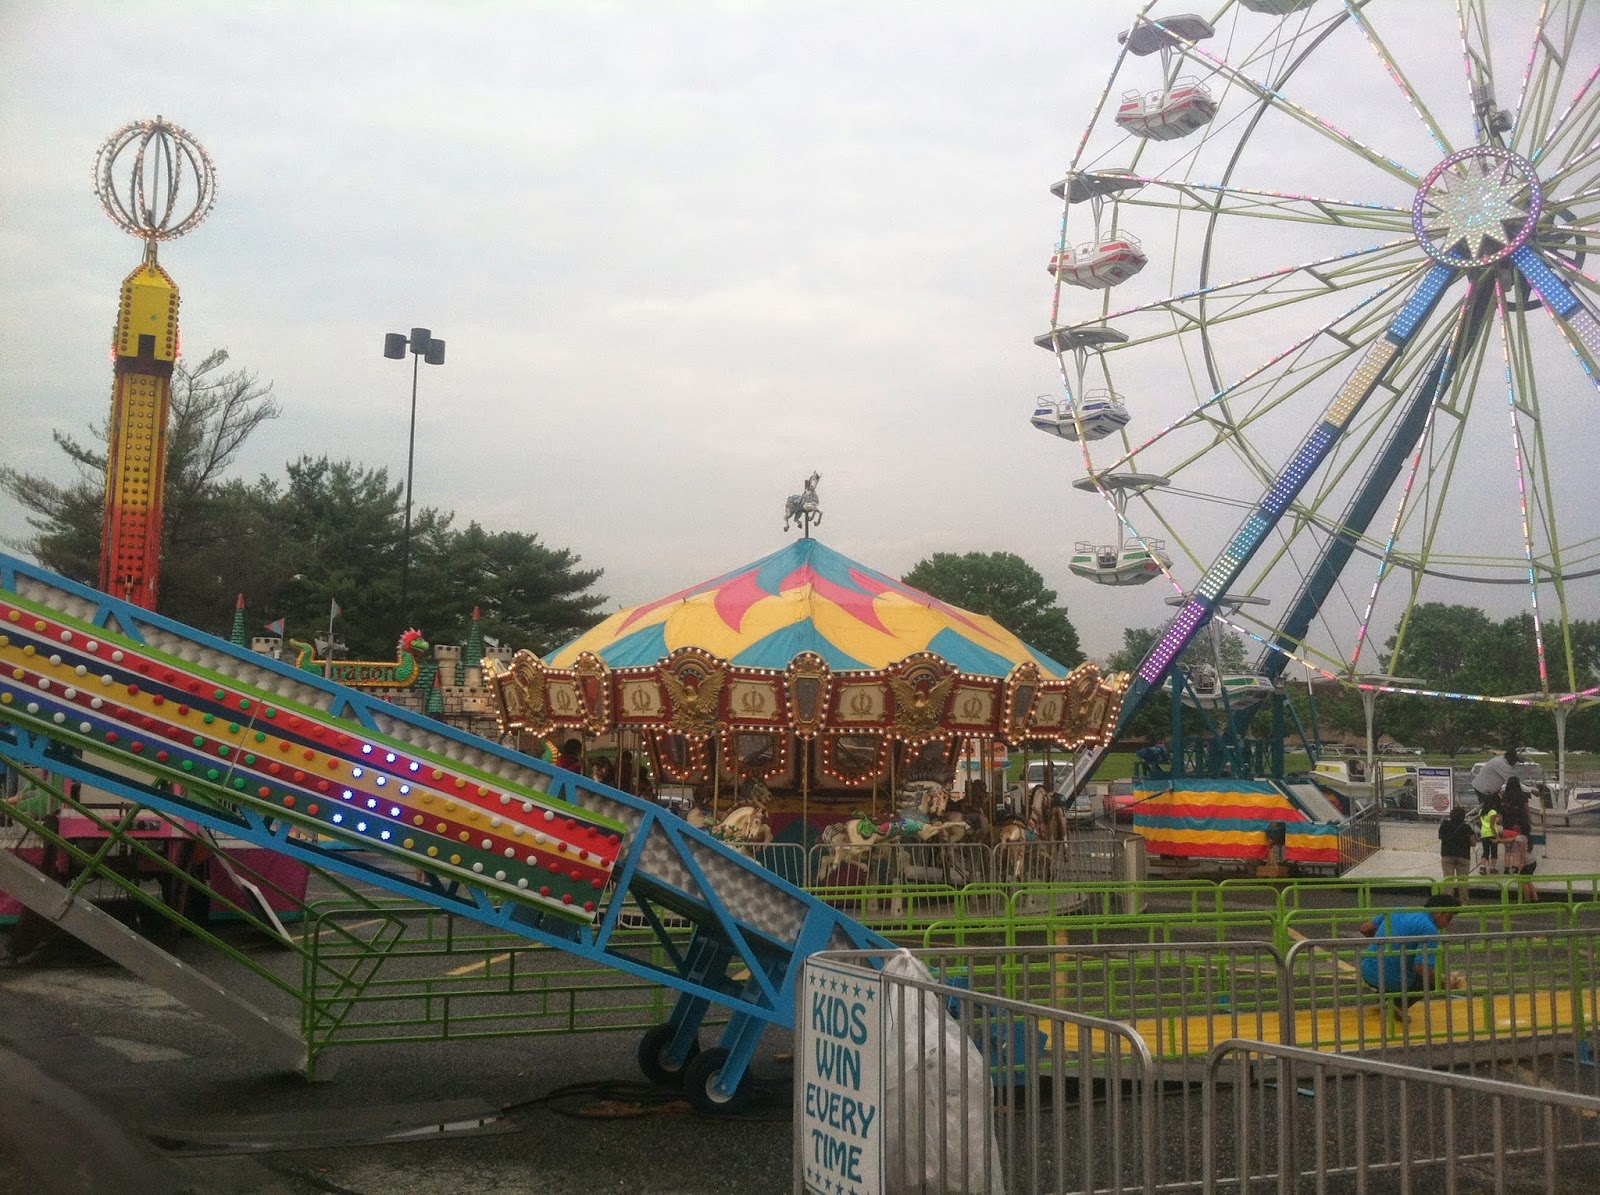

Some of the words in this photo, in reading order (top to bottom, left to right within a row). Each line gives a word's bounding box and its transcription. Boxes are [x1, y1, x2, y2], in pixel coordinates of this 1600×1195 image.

[812, 991, 868, 1045] KIDS
[815, 1037, 861, 1091] WIN
[806, 1082, 875, 1139] EVERY
[811, 1129, 863, 1184] TIME
